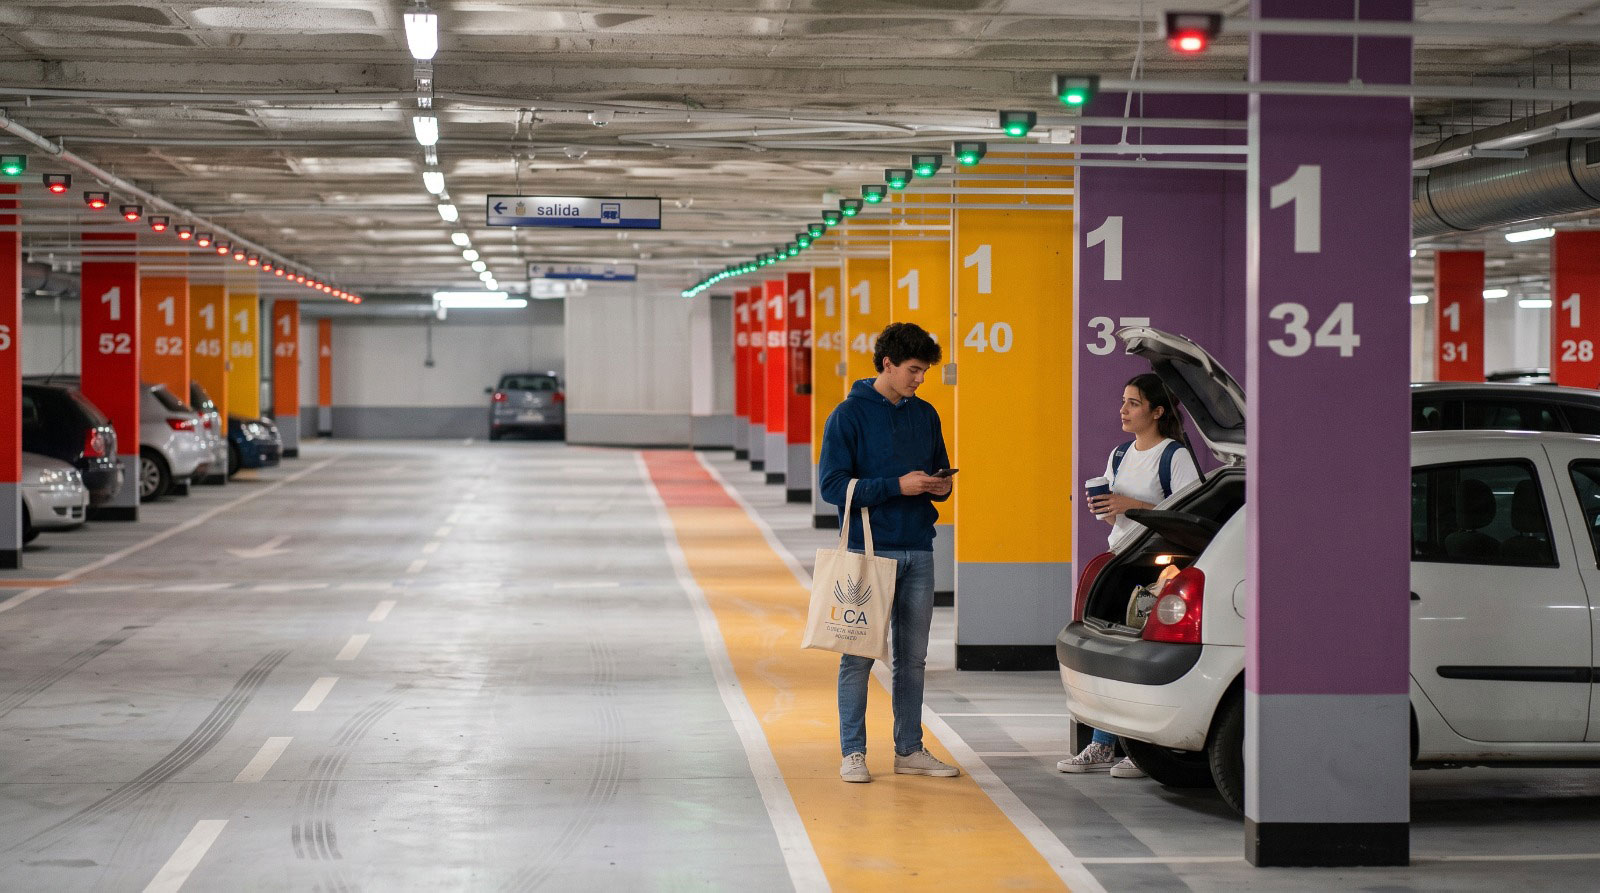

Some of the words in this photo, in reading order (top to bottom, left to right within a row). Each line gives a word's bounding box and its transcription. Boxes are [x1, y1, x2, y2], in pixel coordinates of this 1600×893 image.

[537, 204, 580, 216] salida
[1270, 165, 1321, 253] 1
[1086, 216, 1123, 281] 1
[964, 244, 991, 294] 1
[101, 286, 121, 320] 1
[818, 286, 835, 317] 1
[850, 281, 870, 315] 1
[897, 269, 919, 310] 1
[158, 296, 175, 325] 1
[199, 304, 214, 330] 1
[737, 303, 749, 323] 1
[751, 300, 765, 321] 1
[768, 295, 783, 320] 1
[789, 289, 806, 318] 1
[1443, 302, 1460, 332] 1
[1562, 293, 1580, 328] 1
[234, 309, 248, 333] 1
[278, 314, 291, 336] 1
[1268, 302, 1360, 357] 34
[99, 333, 131, 354] 52
[155, 337, 183, 356] 52
[195, 339, 220, 357] 45
[964, 322, 1013, 353] 40
[1561, 340, 1593, 362] 28
[1442, 342, 1468, 362] 31
[830, 606, 868, 625] UCA
